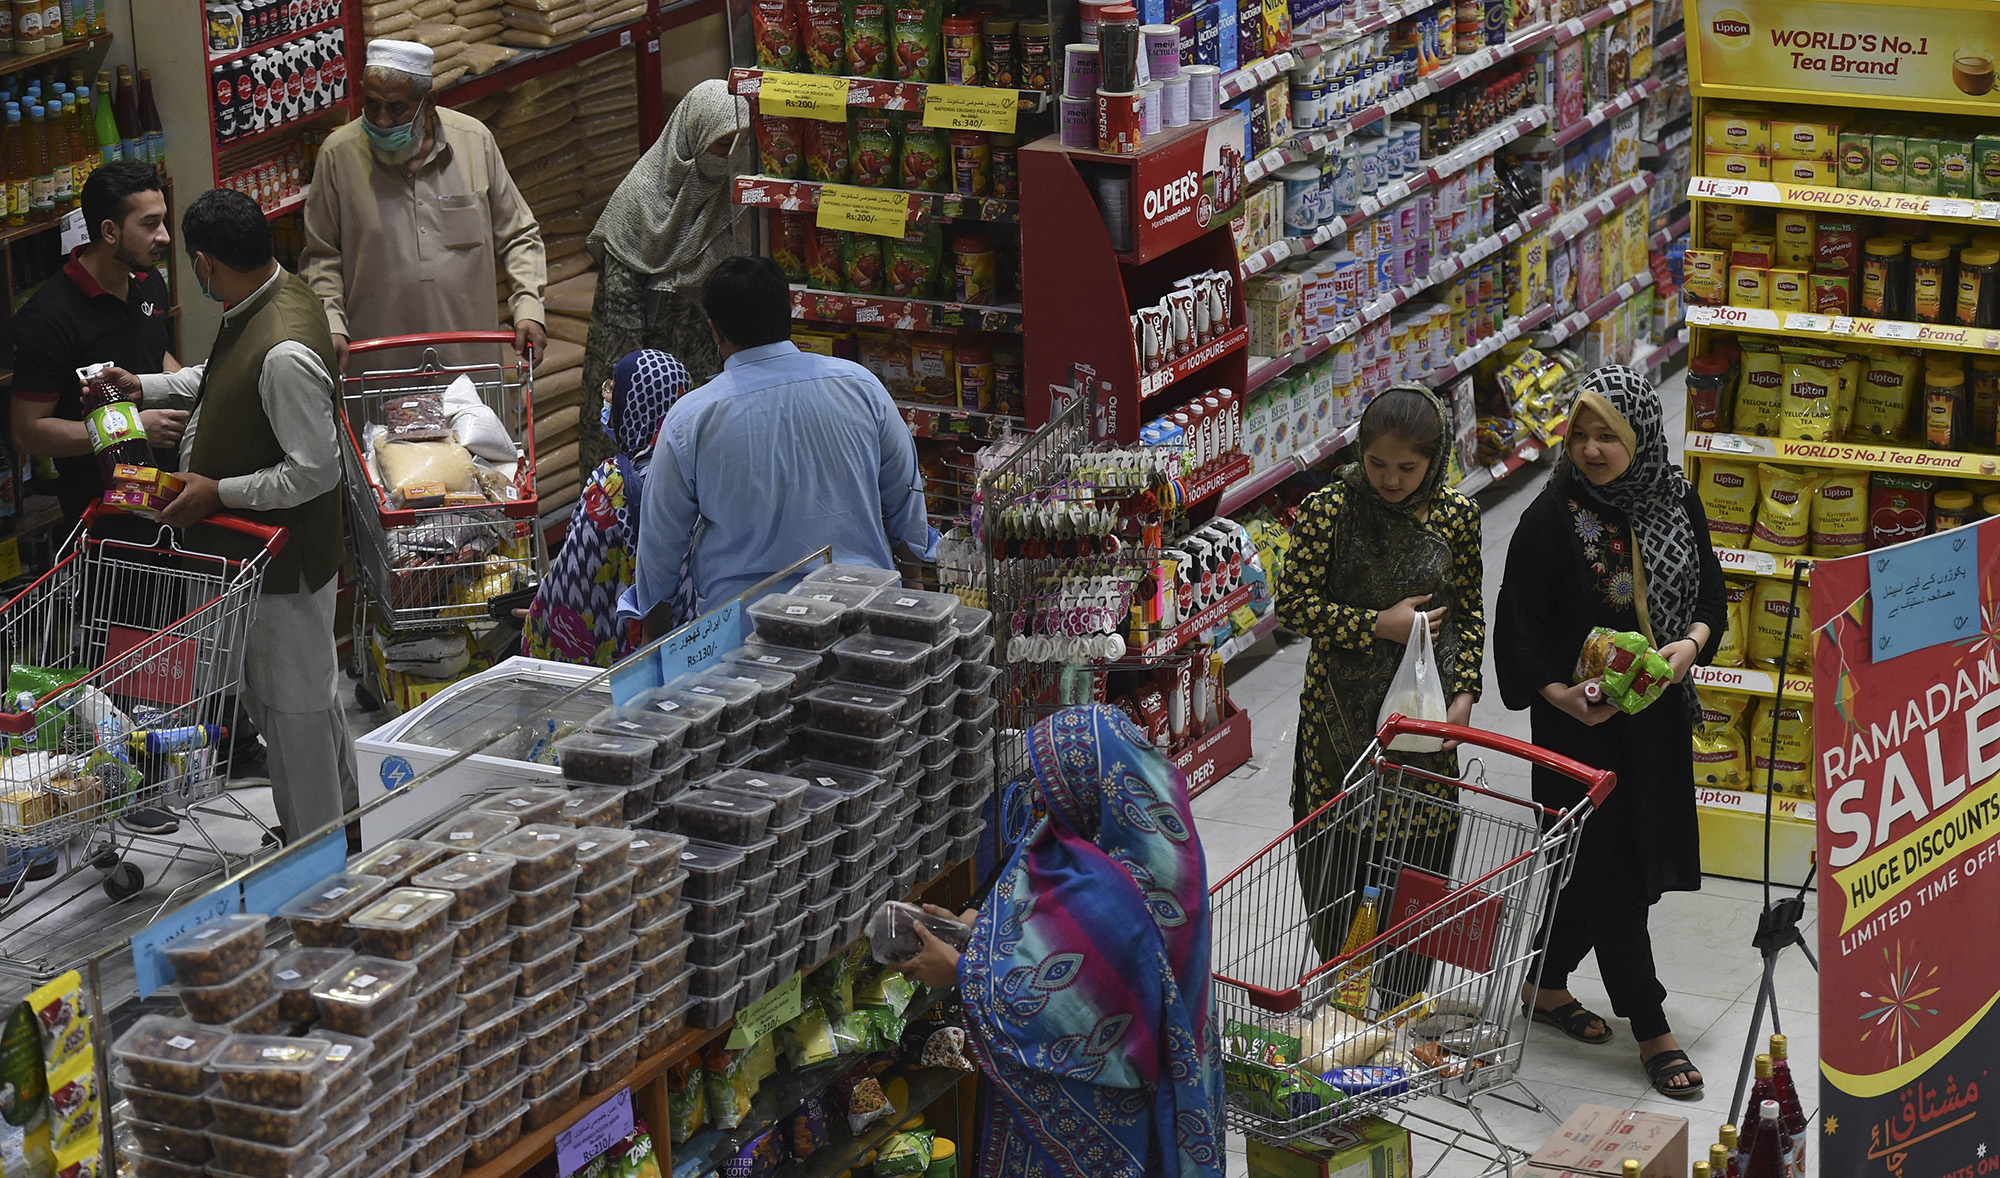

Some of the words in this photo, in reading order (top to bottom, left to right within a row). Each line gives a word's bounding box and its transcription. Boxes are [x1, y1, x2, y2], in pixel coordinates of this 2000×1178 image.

[1715, 23, 1747, 33] Lipton
[1154, 40, 1175, 49] meiji
[1771, 29, 1878, 51] WORLD'S
[1881, 36, 1928, 55] No.1
[1790, 52, 1826, 71] Tea
[1830, 53, 1900, 75] Brand
[785, 99, 820, 110] Rs:200/-
[952, 118, 986, 129] Rs:340/-
[1697, 180, 1749, 196] Lipon
[1143, 170, 1199, 220] OLPER'S
[1788, 189, 1859, 206] WORLD'S
[1859, 195, 1890, 208] No.1
[1895, 198, 1918, 211] Tea
[846, 212, 877, 223] Rs:200/-
[1335, 279, 1355, 291] BIG
[1739, 279, 1758, 288] Lipton
[1779, 282, 1797, 290] Lipton
[1751, 373, 1782, 387] Lipton
[1868, 372, 1900, 385] Lipton
[1793, 385, 1825, 398] Lipton
[1742, 398, 1768, 407] YELLOW
[1858, 397, 1884, 406] YELLOW
[1884, 401, 1905, 410] LABEL
[1873, 406, 1886, 414] TEA
[1783, 444, 1853, 460] WORLD'S
[1854, 450, 1886, 462] No.1
[1890, 452, 1912, 464] Tea
[1915, 454, 1963, 467] Brand
[1715, 475, 1742, 486] Lipton
[1773, 491, 1797, 502] Lipton
[1824, 487, 1851, 498] Lipton
[1713, 497, 1738, 505] KHYBER
[1758, 626, 1783, 636] YELLOW
[687, 641, 718, 667] Rs:130/-
[1692, 667, 1743, 684] Lipton
[1701, 711, 1729, 721] Lipton
[1822, 649, 1999, 789] RAMADAN
[1197, 743, 1207, 754] FULL
[1826, 688, 2000, 868] SALE
[1694, 787, 1742, 805] Lipton
[1850, 862, 1901, 909] HUGE
[1904, 792, 2000, 876] DISCOUNTS
[1841, 900, 1912, 957] LIMITED
[1917, 871, 1959, 906] TIME
[583, 1134, 614, 1163] Rs:210/-
[626, 1137, 652, 1167] TANG
[1977, 1154, 1999, 1176] ON
